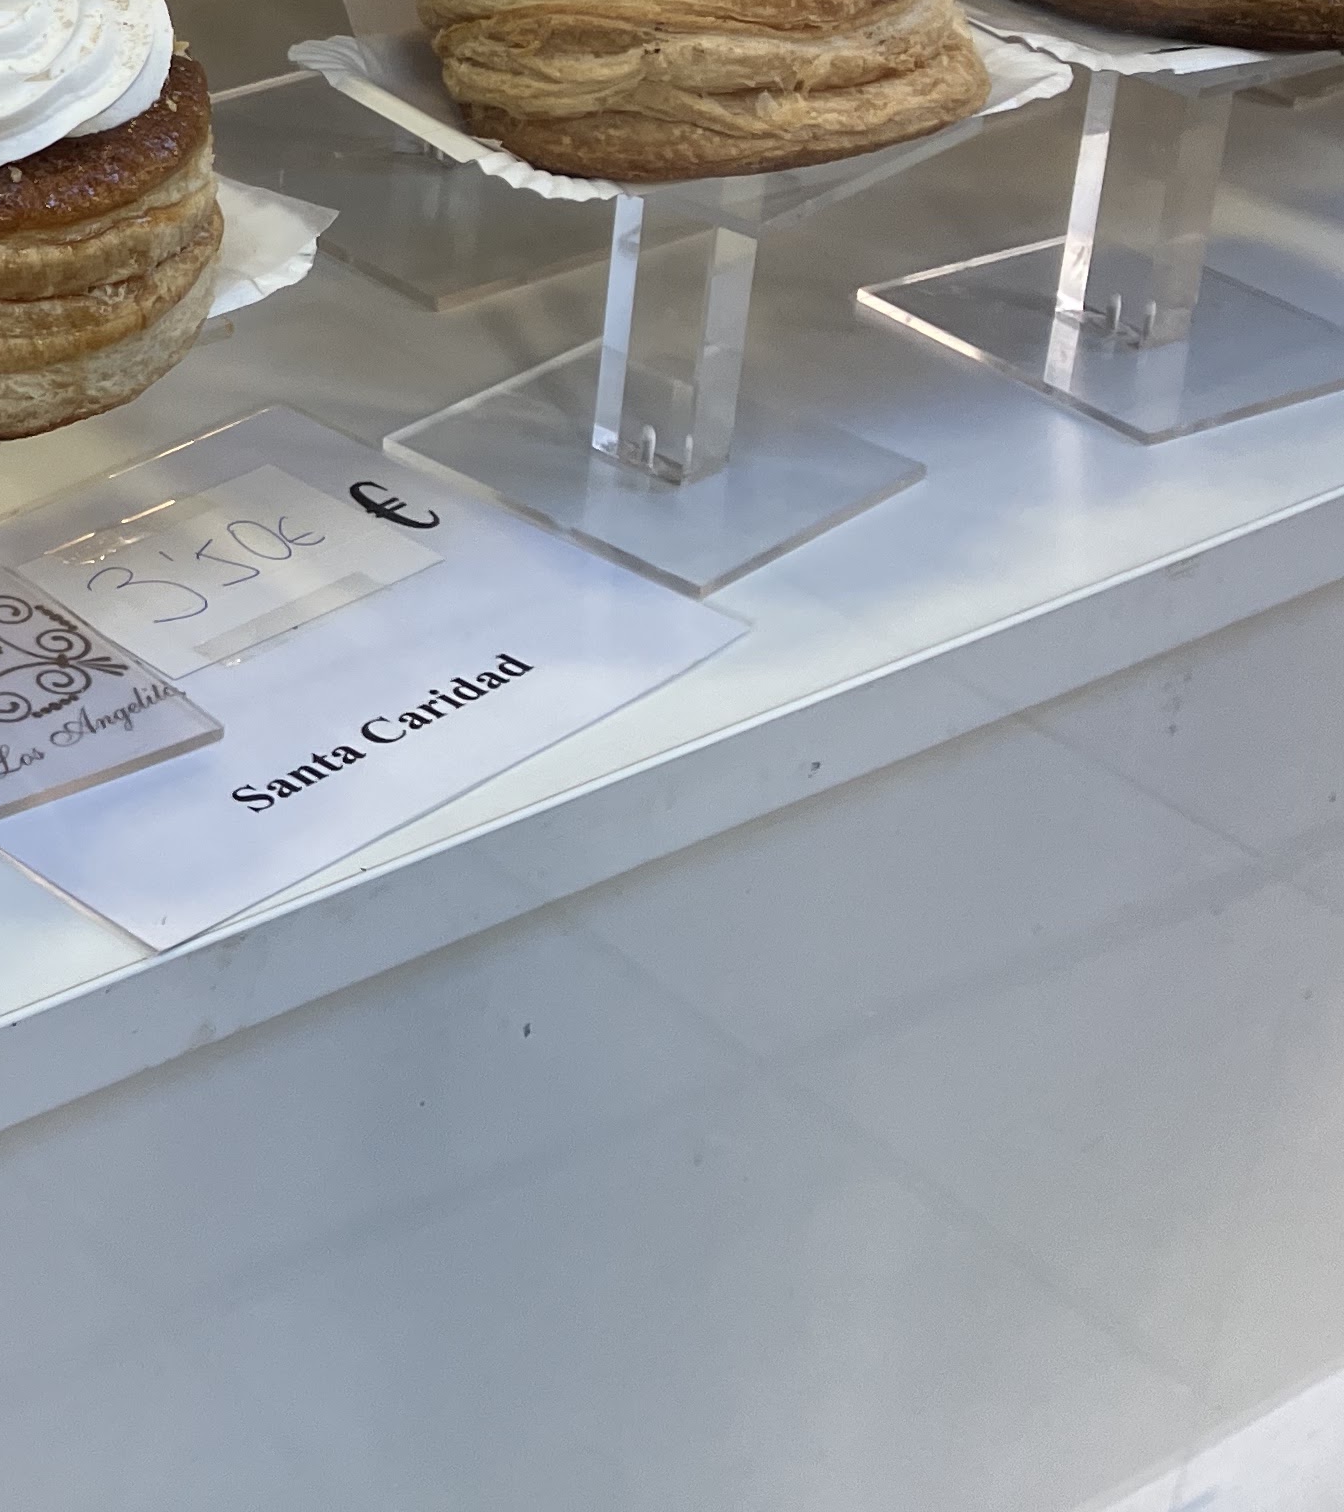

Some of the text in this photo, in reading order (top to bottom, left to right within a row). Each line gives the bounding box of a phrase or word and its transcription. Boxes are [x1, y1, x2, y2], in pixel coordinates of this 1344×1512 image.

[349, 481, 440, 529] €
[232, 653, 534, 813] Santa Caridad
